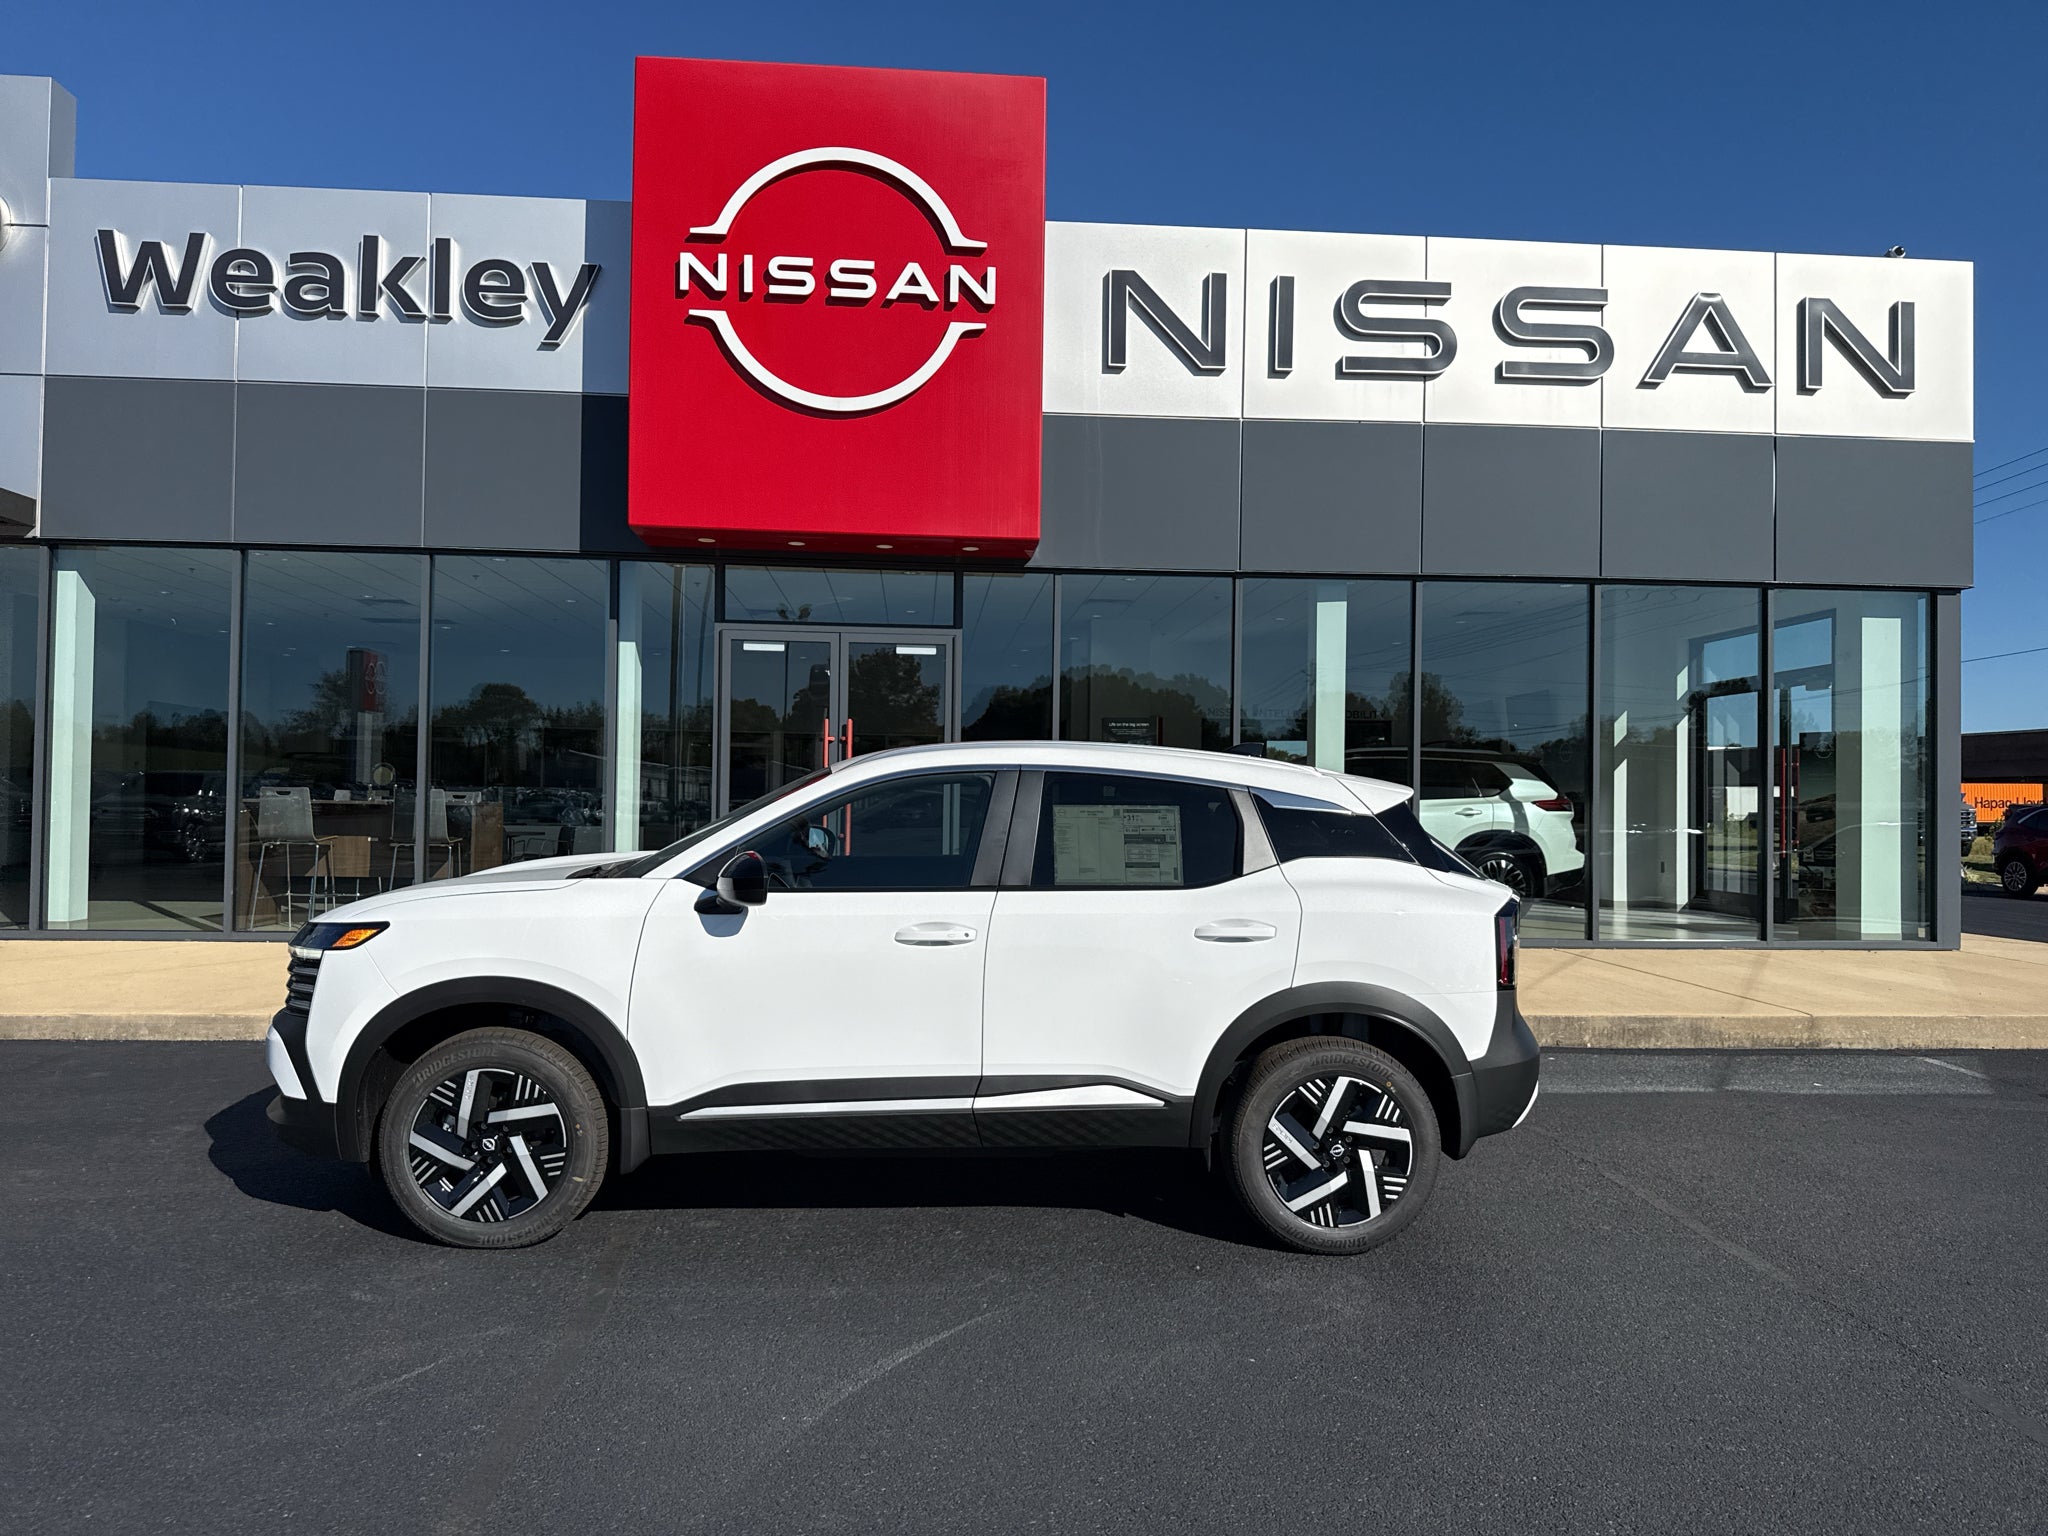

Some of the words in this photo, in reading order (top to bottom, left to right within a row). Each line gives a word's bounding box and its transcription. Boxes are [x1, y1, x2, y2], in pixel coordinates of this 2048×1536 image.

[95, 228, 601, 346] Weakley
[678, 251, 997, 306] NISSAN
[1105, 269, 1916, 397] NISSAN
[412, 1047, 499, 1088] BRIDGESTONE
[1310, 1053, 1396, 1081] BRIDGESTONE
